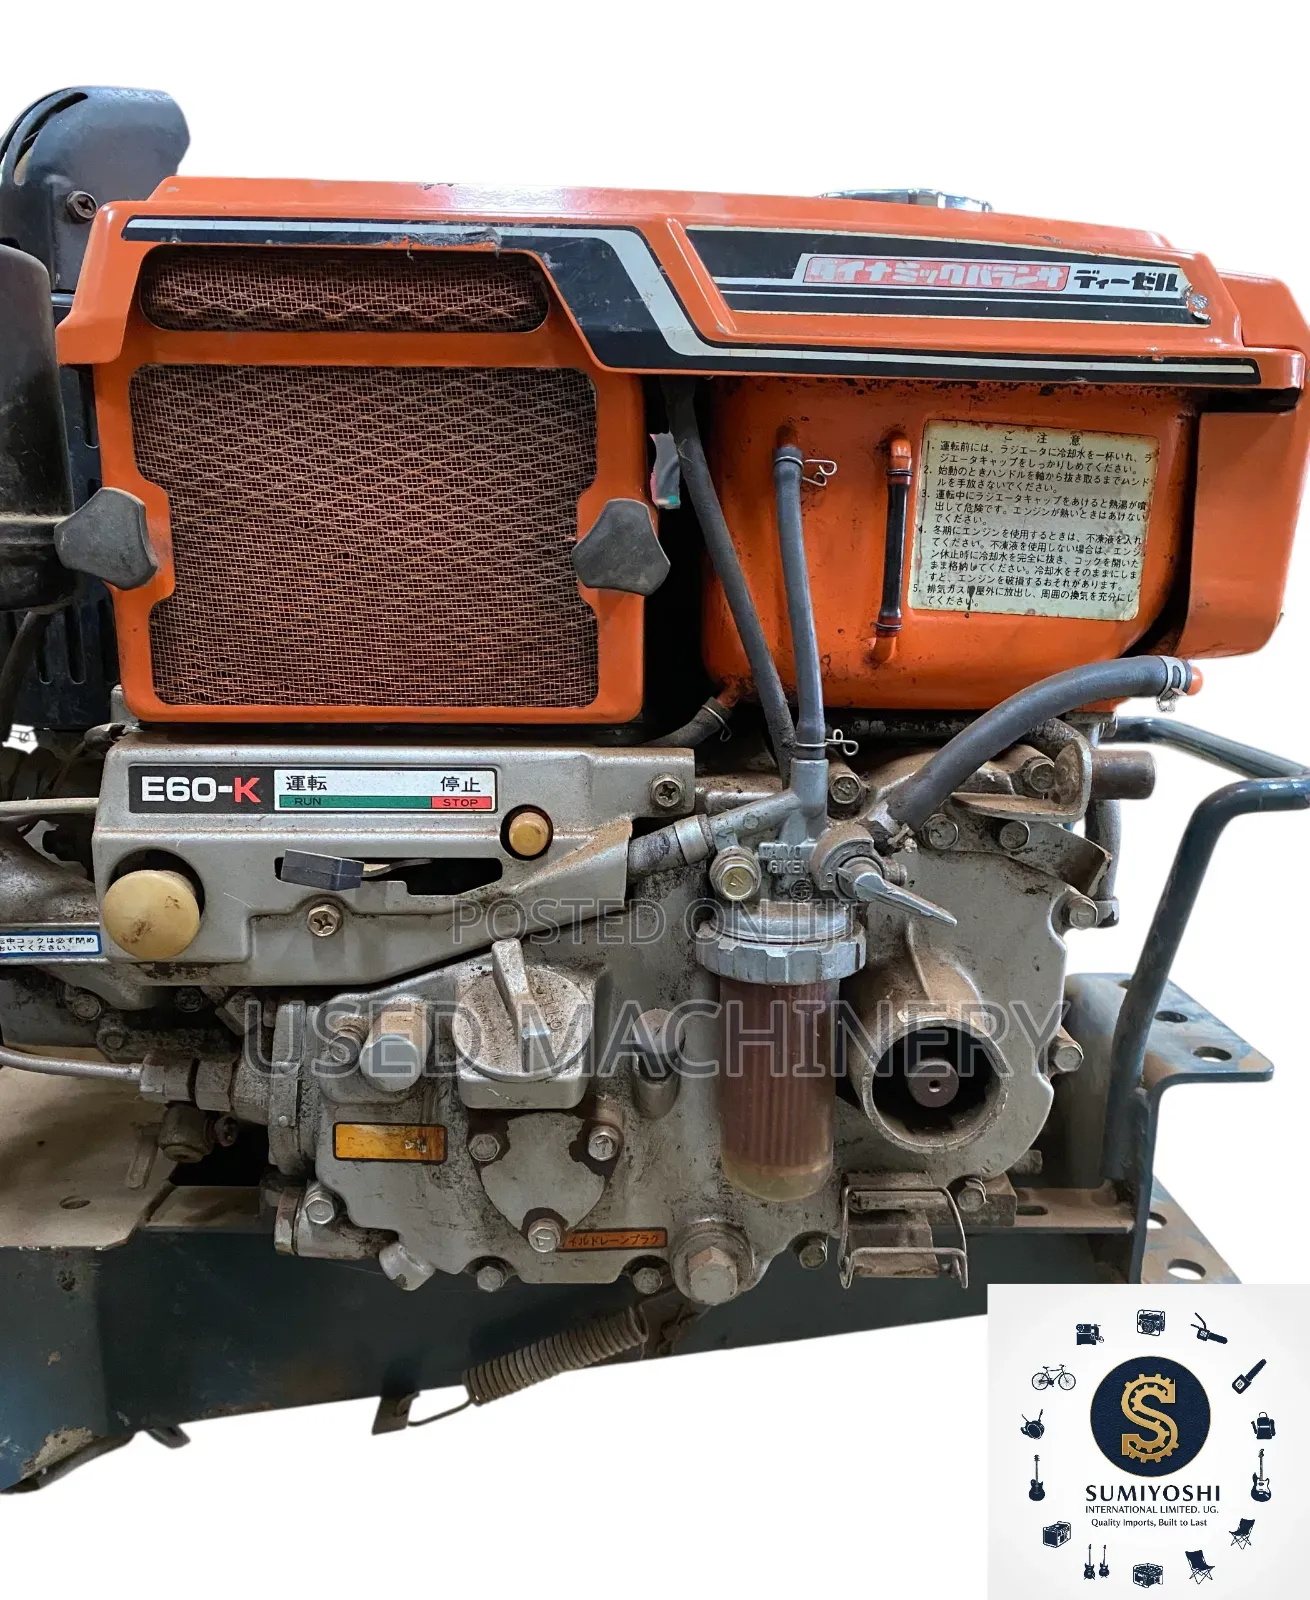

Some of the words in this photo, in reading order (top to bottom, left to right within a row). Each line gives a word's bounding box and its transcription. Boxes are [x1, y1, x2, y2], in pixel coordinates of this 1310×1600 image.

[1074, 268, 1179, 293] ディーゼル
[141, 776, 262, 803] E60-K
[286, 775, 328, 791] 運転
[440, 775, 481, 793] 停止
[294, 797, 322, 807] RUN
[443, 798, 478, 807] STOP
